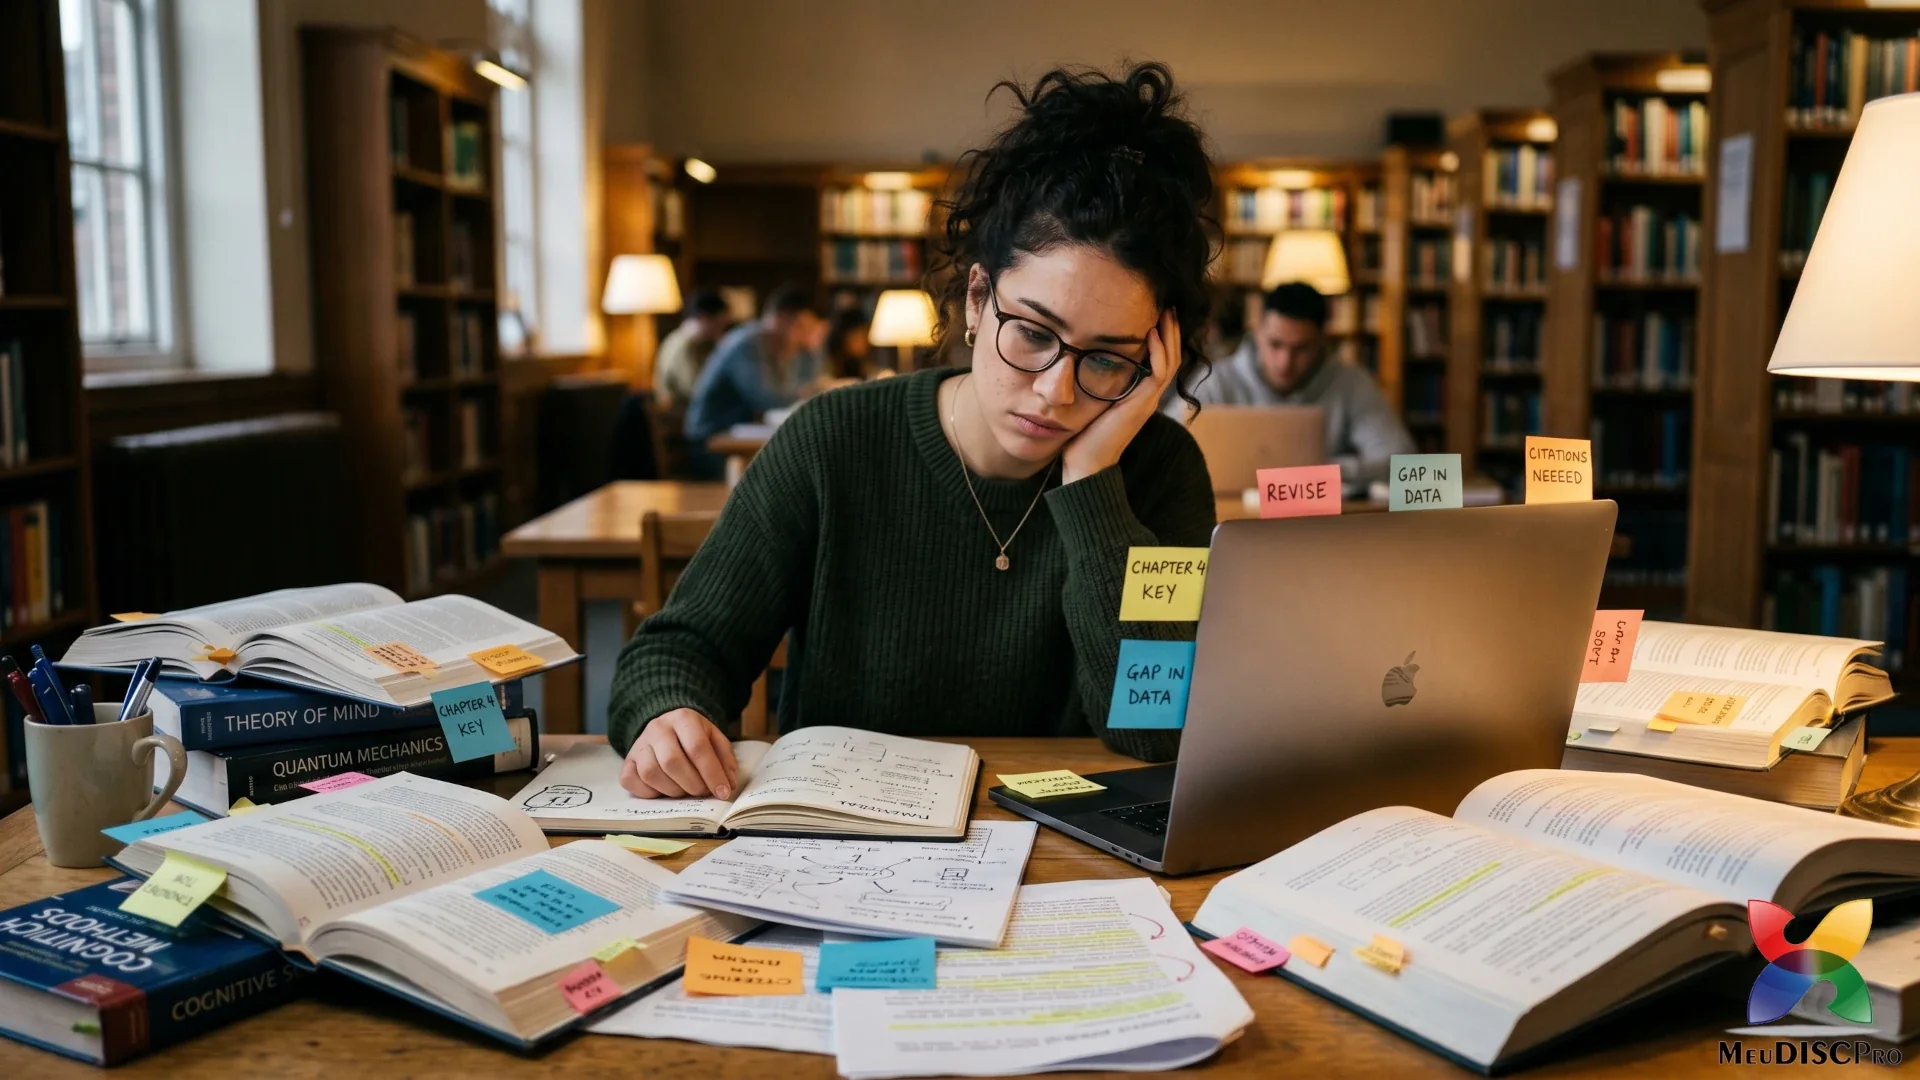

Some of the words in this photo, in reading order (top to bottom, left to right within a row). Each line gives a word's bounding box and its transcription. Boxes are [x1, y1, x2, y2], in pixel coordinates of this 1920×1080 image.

[1528, 446, 1588, 464] CITATIONS
[1398, 466, 1427, 482] GAP
[1433, 467, 1448, 482] IN
[1532, 469, 1583, 485] NEEEED
[1266, 480, 1327, 502] REVISE
[1404, 488, 1442, 505] DATA
[1131, 560, 1193, 576] CHAPTER
[1196, 560, 1206, 576] 4
[1142, 583, 1177, 604] KEY
[1126, 663, 1161, 682] GAP
[1168, 665, 1186, 681] IN
[438, 698, 486, 718] CHAPTER
[486, 693, 496, 708] 4
[1128, 688, 1171, 706] DATA
[224, 709, 298, 733] THEORY
[303, 706, 328, 725] OF
[333, 702, 380, 722] MIND
[457, 718, 485, 738] KEY
[272, 750, 352, 778] QUANTUM
[357, 736, 444, 764] MECHANICS
[31, 906, 173, 954] METHODS
[171, 968, 278, 1023] COGNITIVE
